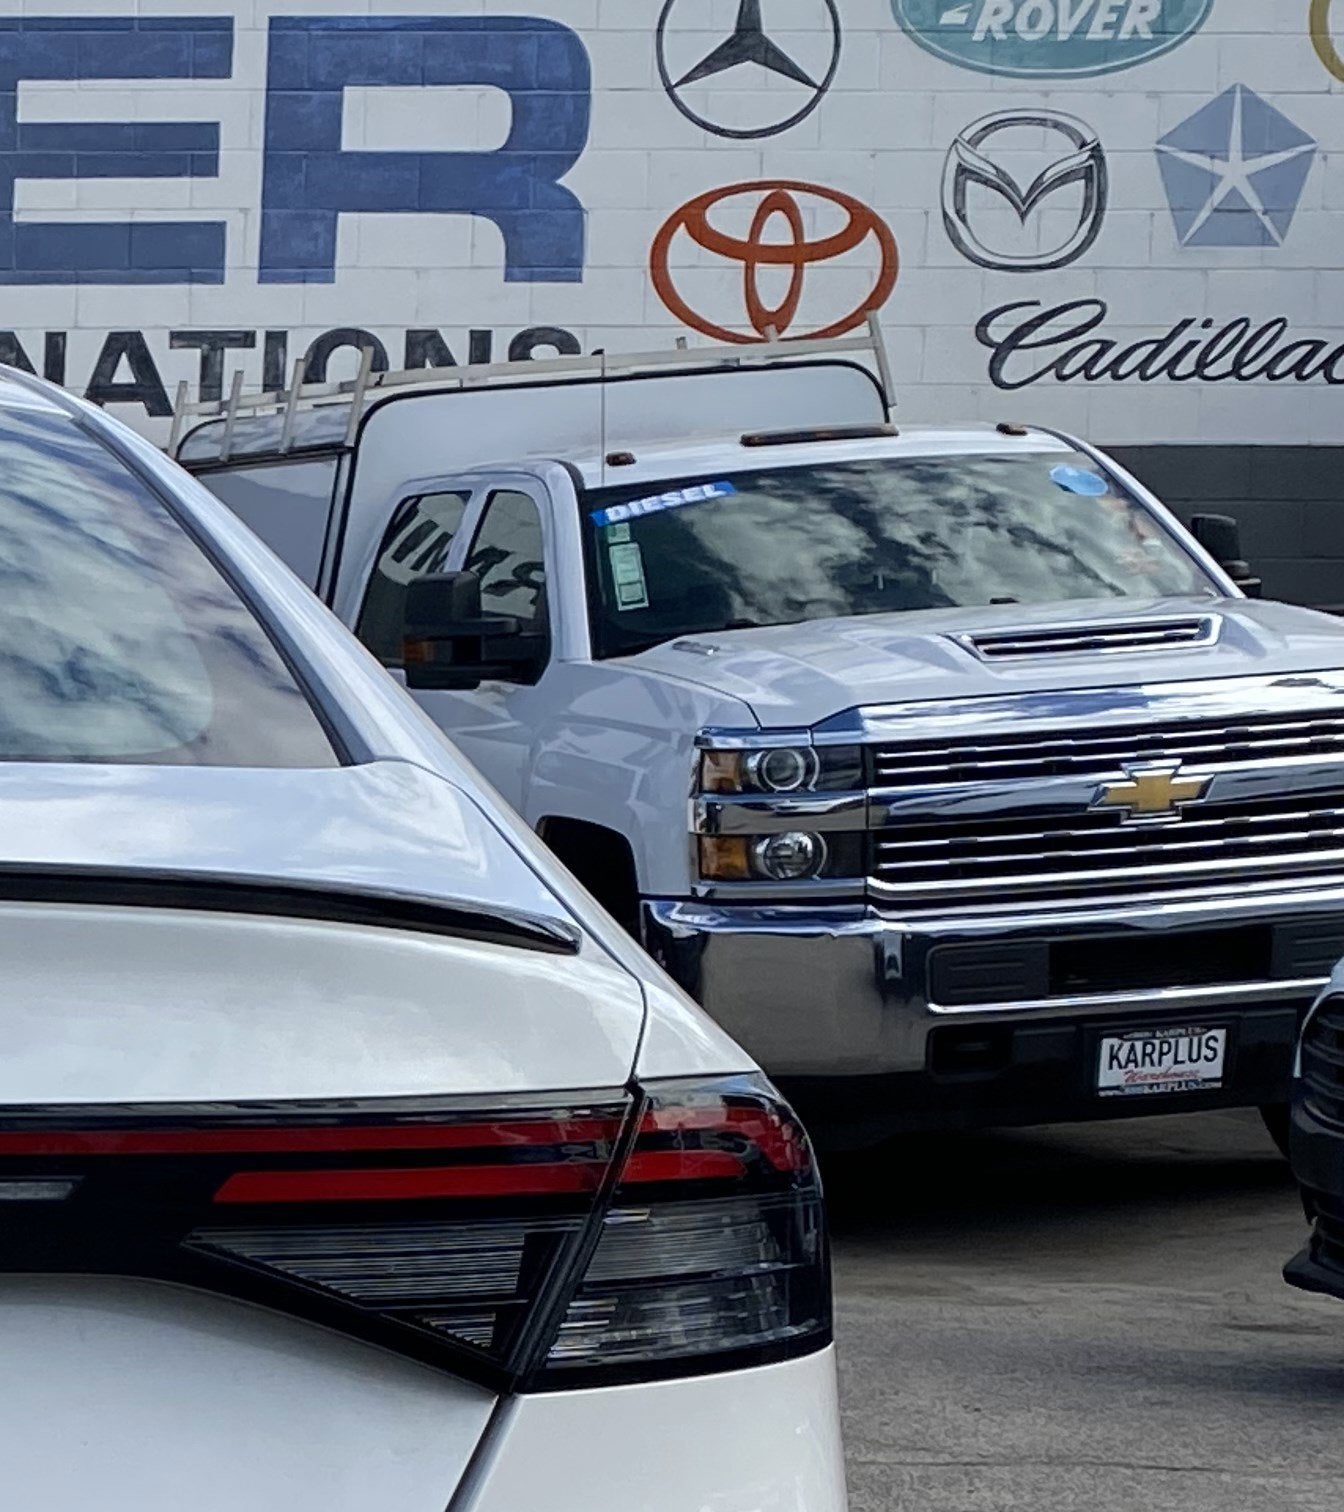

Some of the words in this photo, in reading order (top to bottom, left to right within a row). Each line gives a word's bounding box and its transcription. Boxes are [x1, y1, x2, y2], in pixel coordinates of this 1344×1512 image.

[971, 0, 1161, 42] ROVER
[604, 482, 729, 523] DIESEL
[1107, 1034, 1219, 1071] KARPLUS
